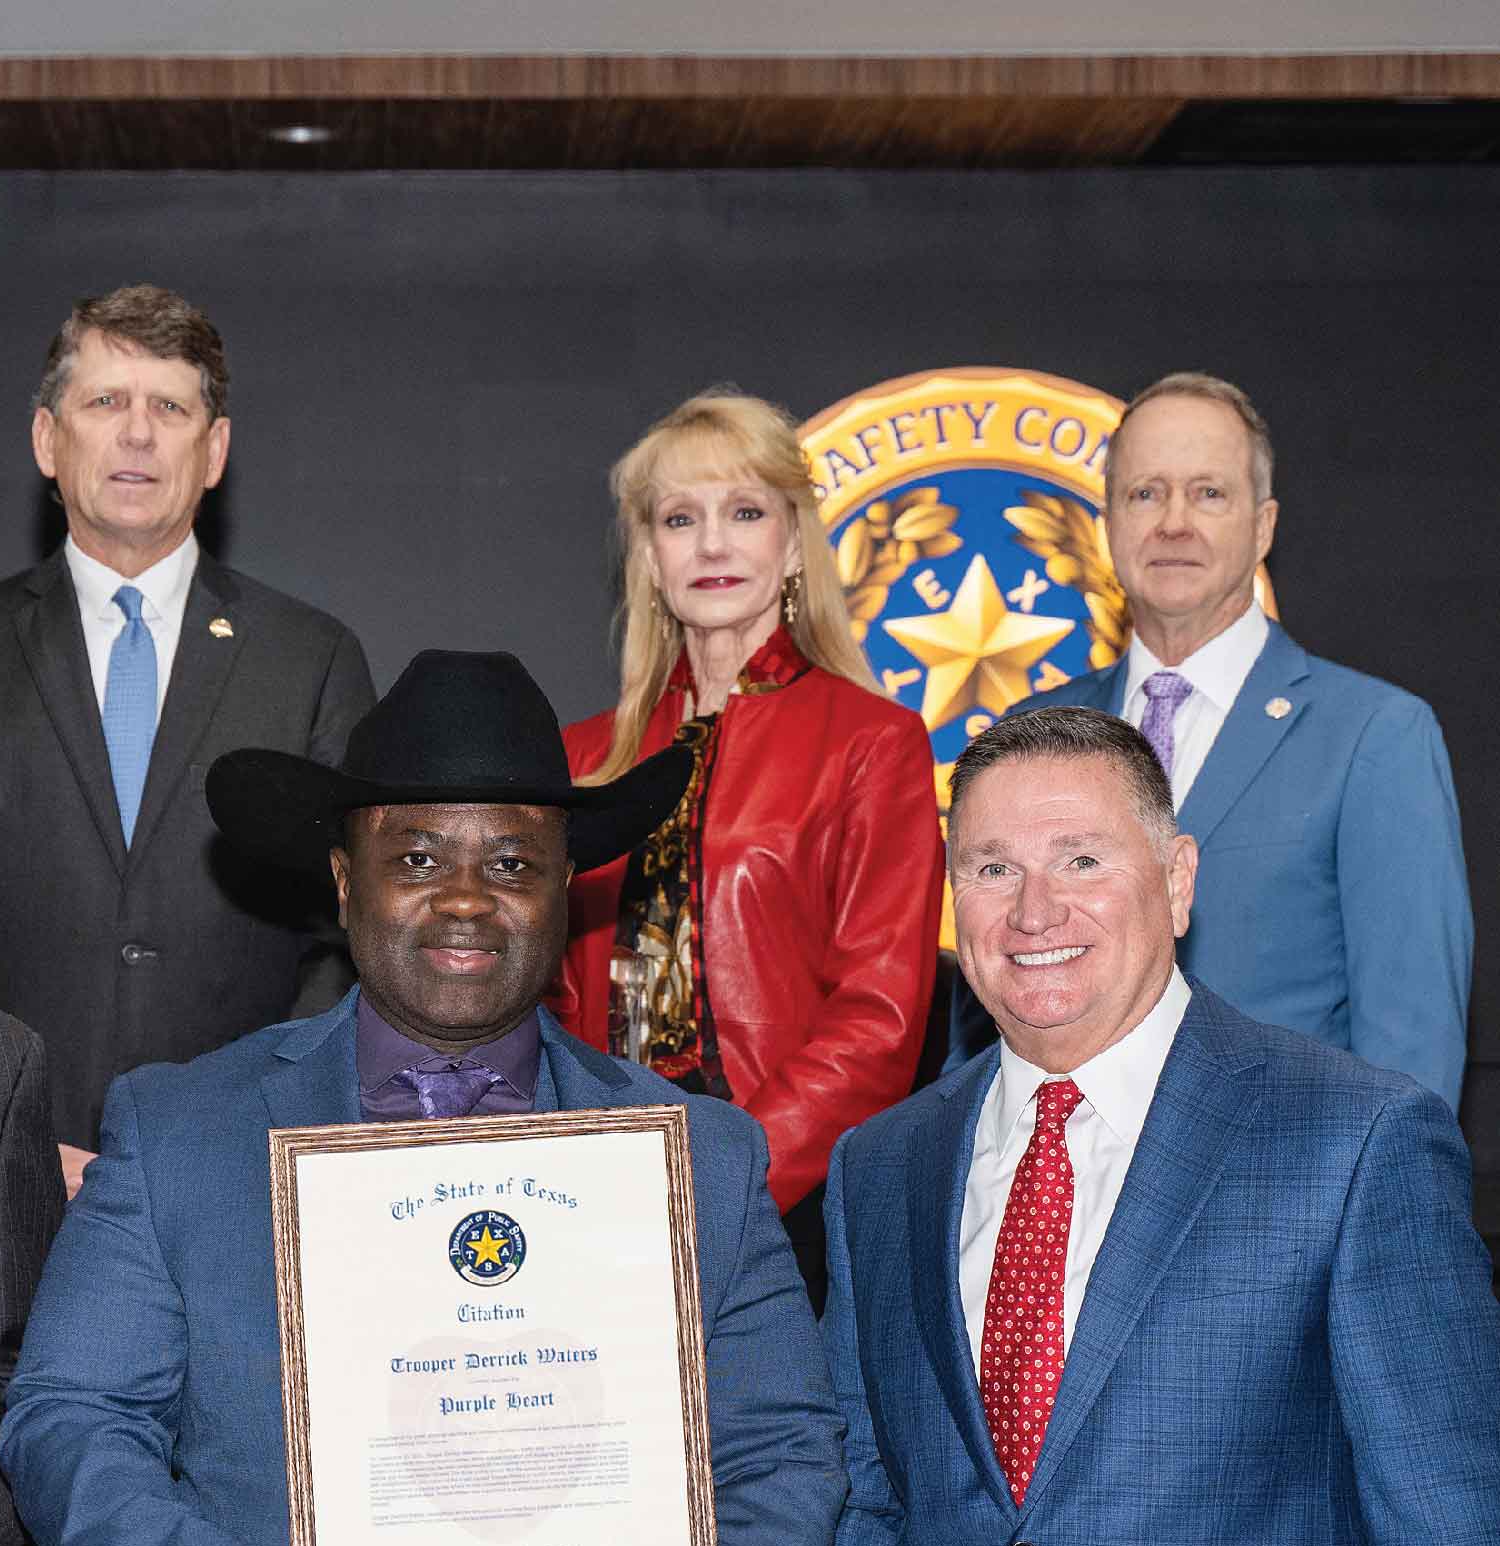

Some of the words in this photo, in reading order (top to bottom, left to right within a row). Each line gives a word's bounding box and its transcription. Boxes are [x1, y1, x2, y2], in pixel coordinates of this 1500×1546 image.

[391, 1196, 424, 1221] The
[432, 1181, 485, 1204] State
[495, 1177, 513, 1196] of
[521, 1178, 578, 1209] Texas
[457, 1303, 525, 1323] Citation
[391, 1358, 456, 1374] Trooper
[464, 1351, 528, 1370] Derrick
[536, 1347, 599, 1364] Waters
[439, 1394, 496, 1415] Purple
[505, 1391, 554, 1411] Heart
